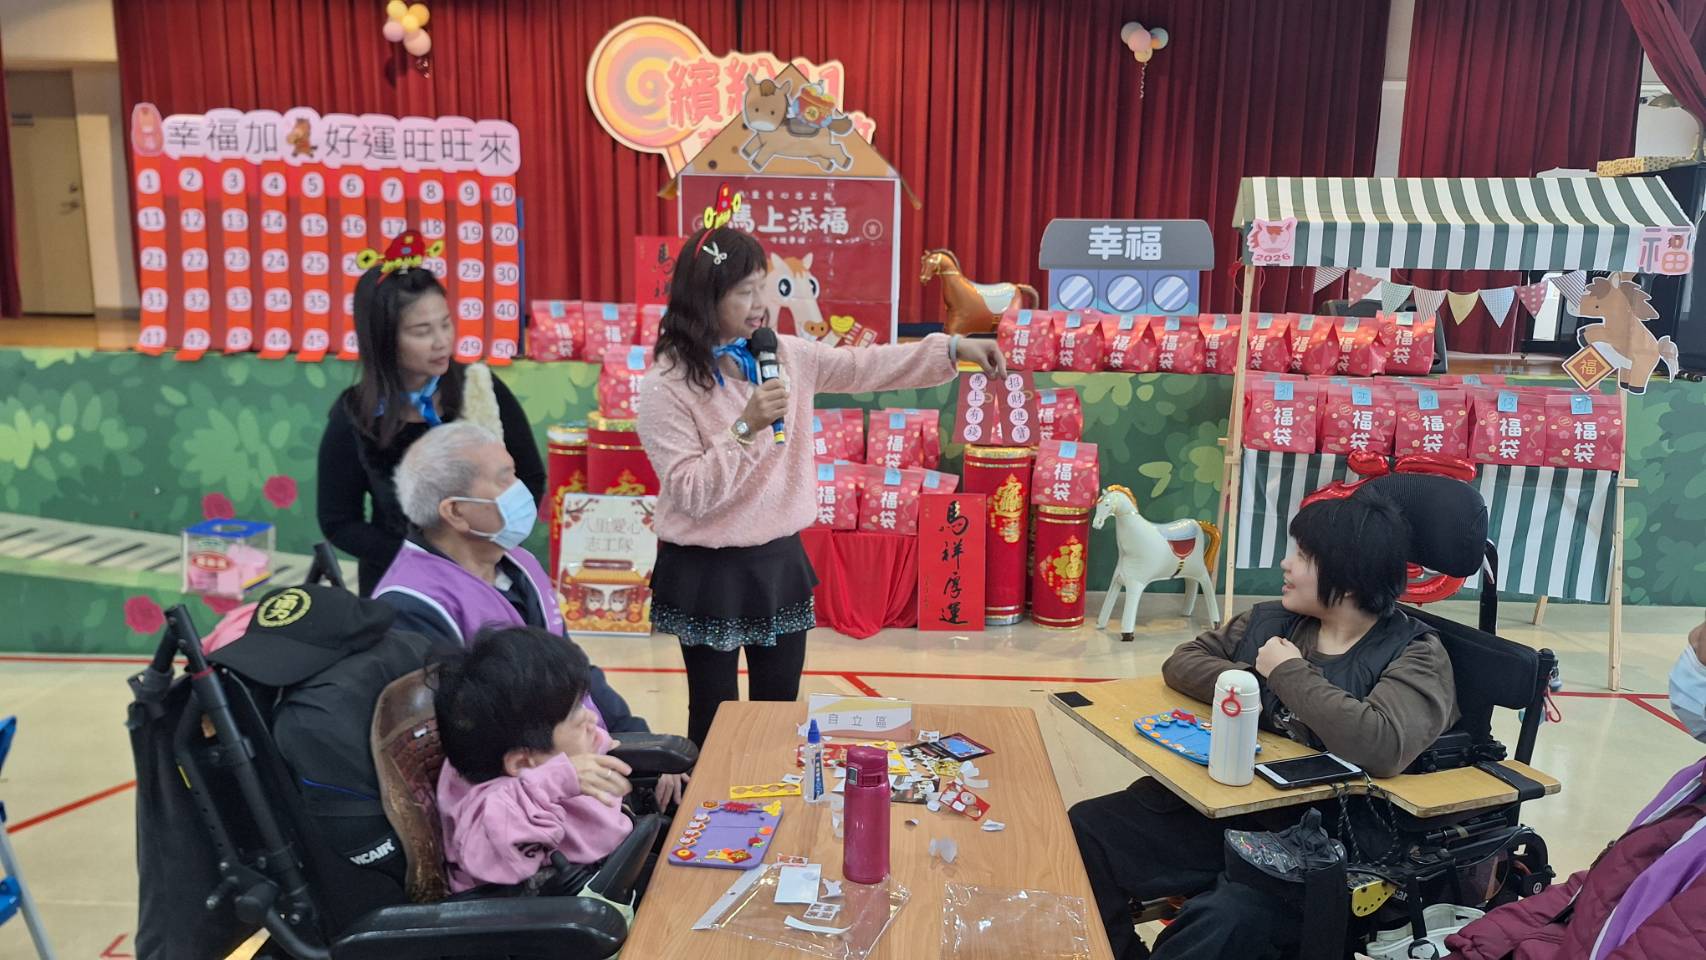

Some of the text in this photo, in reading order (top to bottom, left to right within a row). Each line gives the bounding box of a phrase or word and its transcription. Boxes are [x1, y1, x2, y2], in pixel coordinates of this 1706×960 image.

[168, 118, 513, 165] 幸福加 好運旺旺來
[145, 170, 512, 200] 1 2 3 4 5 6 7 8 9 10
[144, 212, 161, 225] 11
[184, 213, 200, 226] 12
[228, 214, 244, 226] 13
[265, 214, 283, 227] 14
[307, 219, 325, 232] 15
[346, 219, 364, 232] 16
[424, 222, 442, 234] 18
[464, 227, 481, 240] 19
[495, 228, 514, 241] 20
[728, 203, 849, 235] 馬上添福
[1088, 225, 1163, 261] 幸福
[1255, 253, 1290, 262] 2026
[1639, 225, 1691, 274] 福
[145, 254, 163, 266] 21
[186, 254, 204, 266] 22
[229, 253, 247, 266] 23
[267, 254, 285, 267] 24
[307, 257, 326, 270] 25
[462, 264, 481, 278] 29
[495, 267, 516, 281] 30
[148, 294, 516, 317] 31 32 33 34 35 39 40
[143, 332, 162, 344] 41
[189, 334, 206, 346] 42
[230, 333, 248, 345] 43
[270, 334, 288, 345] 44
[308, 334, 325, 346] 45
[460, 341, 480, 354] 49
[495, 344, 514, 356] 50
[555, 322, 573, 358] 福袋
[605, 325, 621, 346] 福
[1012, 330, 1030, 366] 福袋
[1059, 331, 1077, 367] 福袋
[1110, 334, 1130, 369] 福袋
[1158, 335, 1178, 369] 福袋
[1249, 334, 1265, 370] 福袋
[1291, 334, 1309, 370] 福袋
[1338, 334, 1354, 371] 福袋
[1393, 330, 1414, 364] 福袋
[1580, 360, 1597, 375] 福
[1273, 406, 1294, 446] 福袋
[1349, 410, 1374, 451] 福袋
[1423, 415, 1444, 453] 福袋
[1499, 417, 1522, 460] 福袋
[1573, 421, 1598, 464] 福袋
[884, 435, 904, 468] 福袋
[1053, 463, 1073, 501] 福袋
[817, 485, 836, 525] 福袋
[880, 491, 898, 529] 福袋
[828, 713, 887, 728] 自立區
[349, 840, 395, 865] VICAIR
